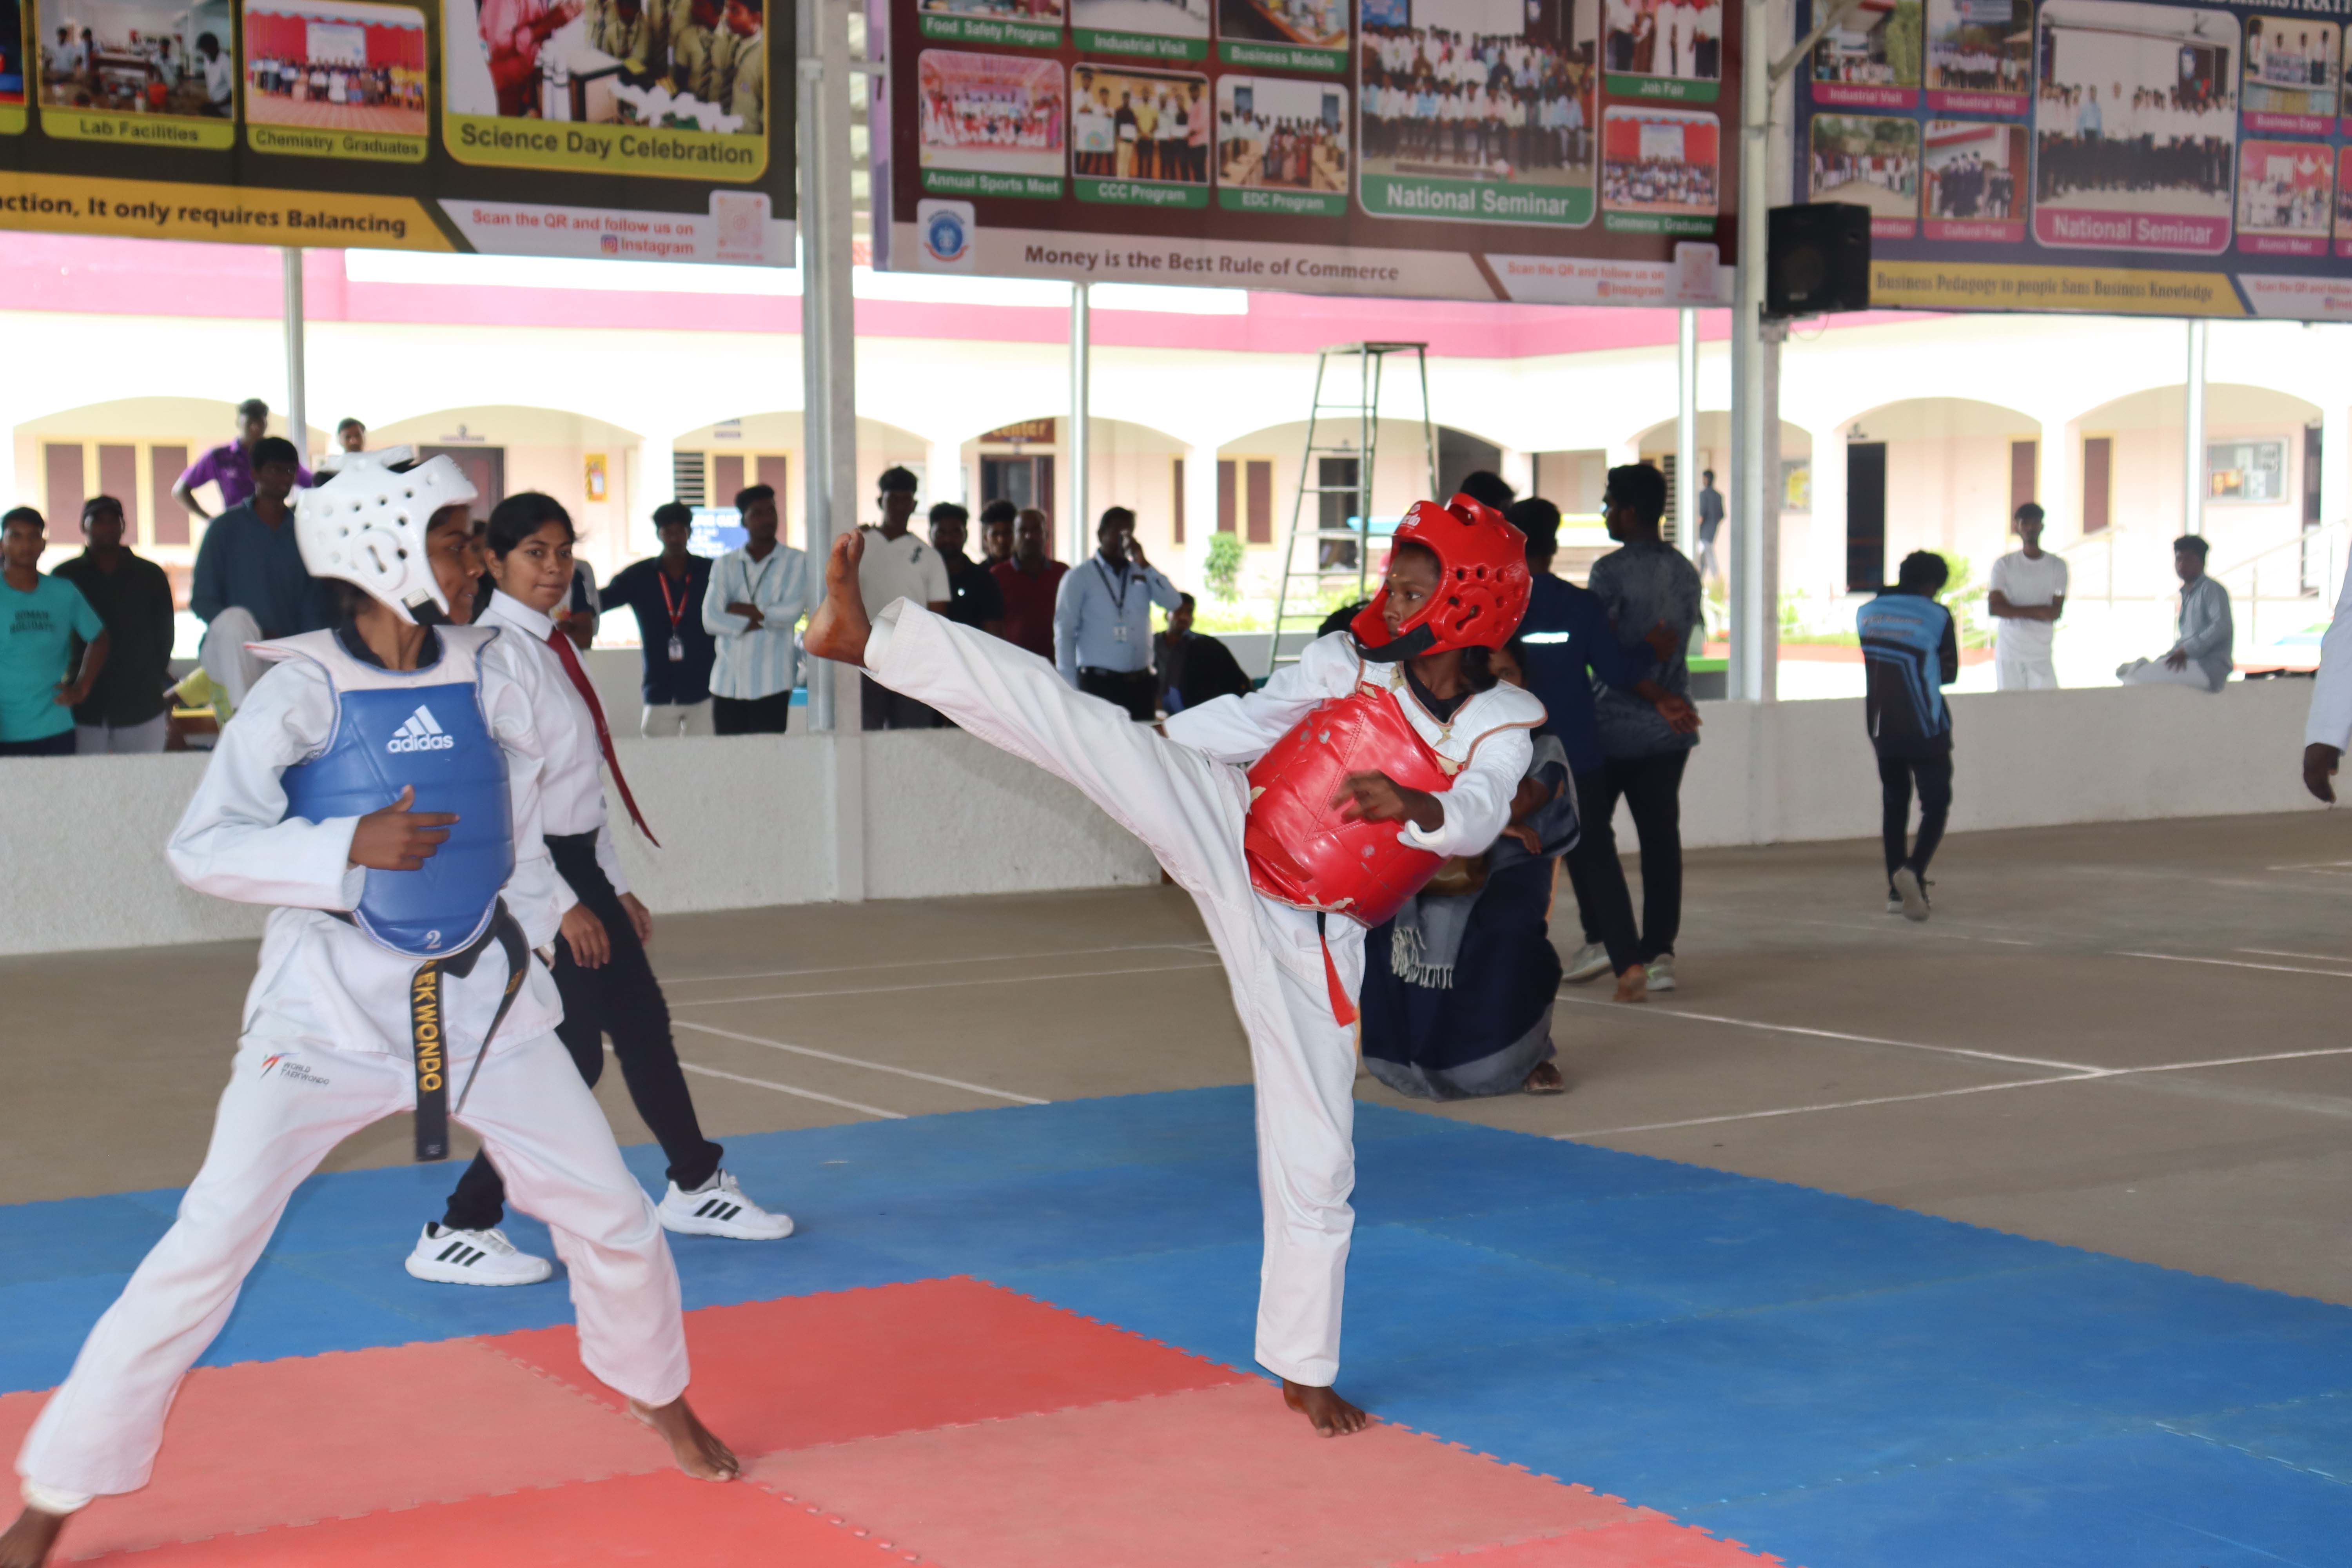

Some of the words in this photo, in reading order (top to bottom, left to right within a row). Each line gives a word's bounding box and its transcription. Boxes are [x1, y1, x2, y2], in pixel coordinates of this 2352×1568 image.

[926, 17, 958, 34] Food
[965, 20, 1001, 41] Safety
[1005, 24, 1057, 44] Program
[1094, 34, 1155, 53] Industrial
[1159, 40, 1187, 56] Visit
[1231, 45, 1288, 64] Business
[1293, 51, 1335, 69] Models
[1641, 81, 1662, 94] Job
[1664, 82, 1685, 96] Fair
[1830, 88, 1878, 102] Industrial
[1881, 91, 1902, 103] Visit
[1946, 95, 1992, 109] Industrial
[1995, 97, 2016, 110] Visit
[80, 119, 113, 136] Lab
[119, 121, 198, 142] Facilities
[256, 130, 333, 152] Chemistry
[343, 135, 419, 154] Graduates
[461, 123, 558, 152] Science
[566, 131, 612, 158] Day
[620, 135, 753, 164] Celebration
[927, 172, 975, 189] Annual
[979, 175, 1023, 194] Sports
[1027, 178, 1059, 194] Meet
[1099, 182, 1127, 197] CCC
[1131, 185, 1186, 204] Program
[1242, 192, 1269, 207] EDC
[1273, 193, 1325, 212] Program
[1387, 183, 1476, 211] National
[1482, 188, 1569, 216] Seminar
[89, 197, 107, 216] It
[114, 201, 170, 226] only
[178, 205, 279, 228] requires
[287, 209, 406, 239] Balancing
[473, 209, 510, 224] Scan
[516, 212, 539, 226] the
[544, 213, 567, 229] QR
[573, 216, 599, 231] and
[605, 218, 648, 232] follow
[654, 222, 671, 234] us
[676, 223, 693, 236] on
[1608, 215, 1659, 231] Commerce
[1665, 217, 1713, 233] Graduates
[2053, 214, 2132, 239] National
[2137, 218, 2214, 245] Seminar
[621, 239, 694, 256] Instagram
[1025, 245, 1098, 271] Money
[1105, 249, 1120, 267] is
[1127, 250, 1162, 269] the
[1169, 252, 1213, 271] Best
[1219, 255, 1264, 274] Rule
[1270, 257, 1290, 275] of
[1296, 259, 1399, 280] Commerce
[1508, 261, 1534, 274] Scan
[1538, 263, 1554, 276] the
[1558, 263, 1575, 276] QR
[1578, 267, 1597, 278] and
[1601, 266, 1632, 279] follow
[1636, 270, 1648, 280] us
[1651, 270, 1665, 280] on
[1612, 284, 1664, 298] Instagram
[1877, 272, 1933, 290] Business
[1936, 274, 1997, 296] Pedagogy
[2001, 279, 2014, 292] to
[2017, 278, 2057, 298] people
[2062, 278, 2090, 295] Sans
[2094, 279, 2146, 297] Business
[2149, 281, 2213, 303] Knowledge
[2255, 281, 2277, 292] Scan
[2279, 282, 2292, 292] the
[387, 733, 454, 754] adidas
[426, 930, 441, 949] 2
[279, 1068, 330, 1085] TAEKWONDO
[283, 1062, 311, 1073] WORLD
